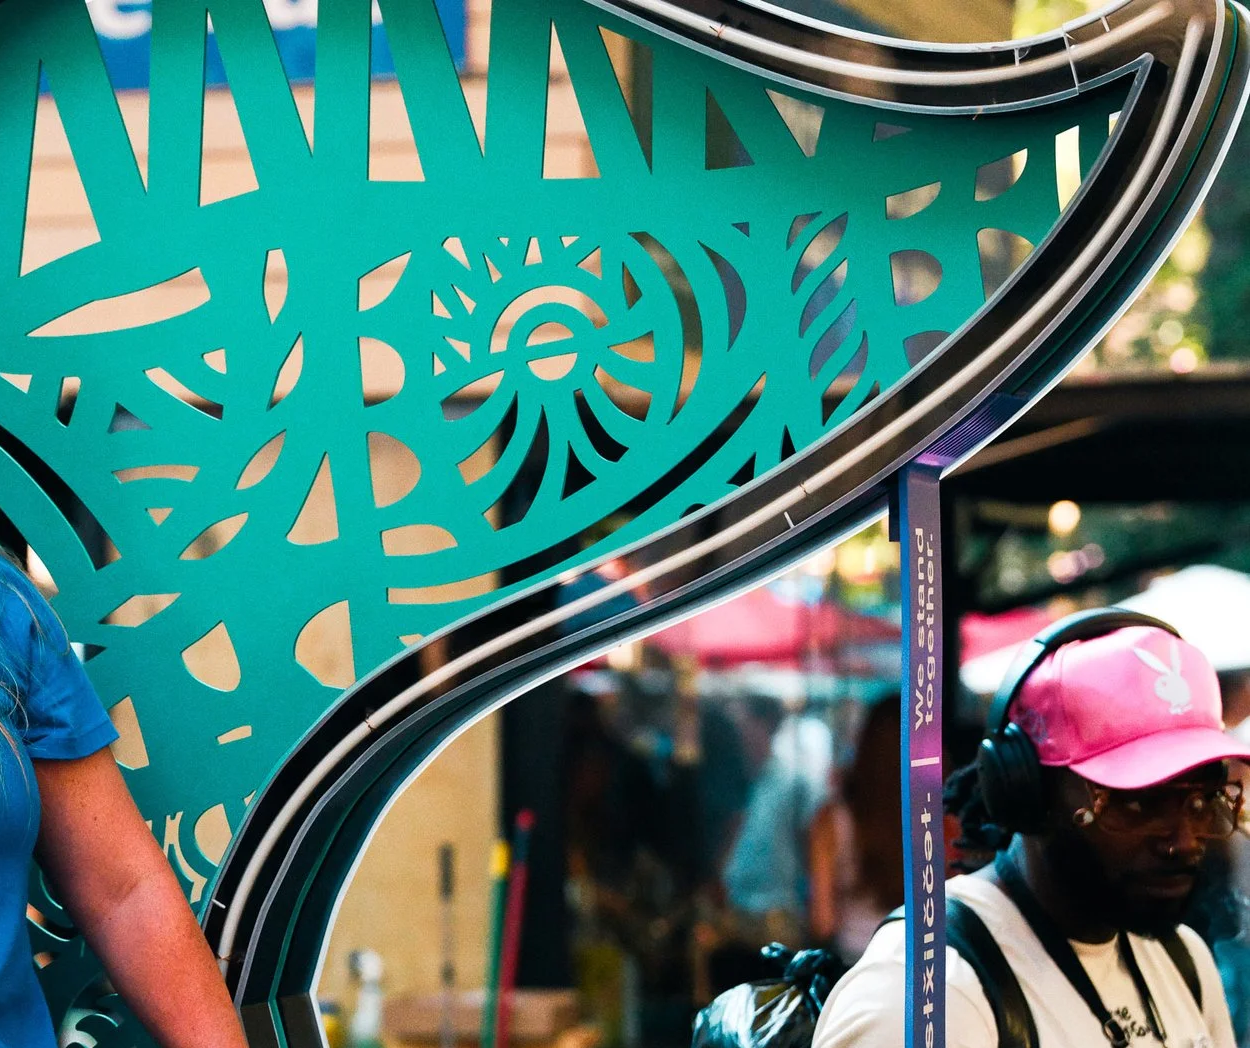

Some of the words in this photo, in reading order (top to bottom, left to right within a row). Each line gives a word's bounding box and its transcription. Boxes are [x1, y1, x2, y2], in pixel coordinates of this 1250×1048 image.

[914, 528, 925, 648] stand
[924, 533, 936, 725] together.
[914, 663, 925, 732] We
